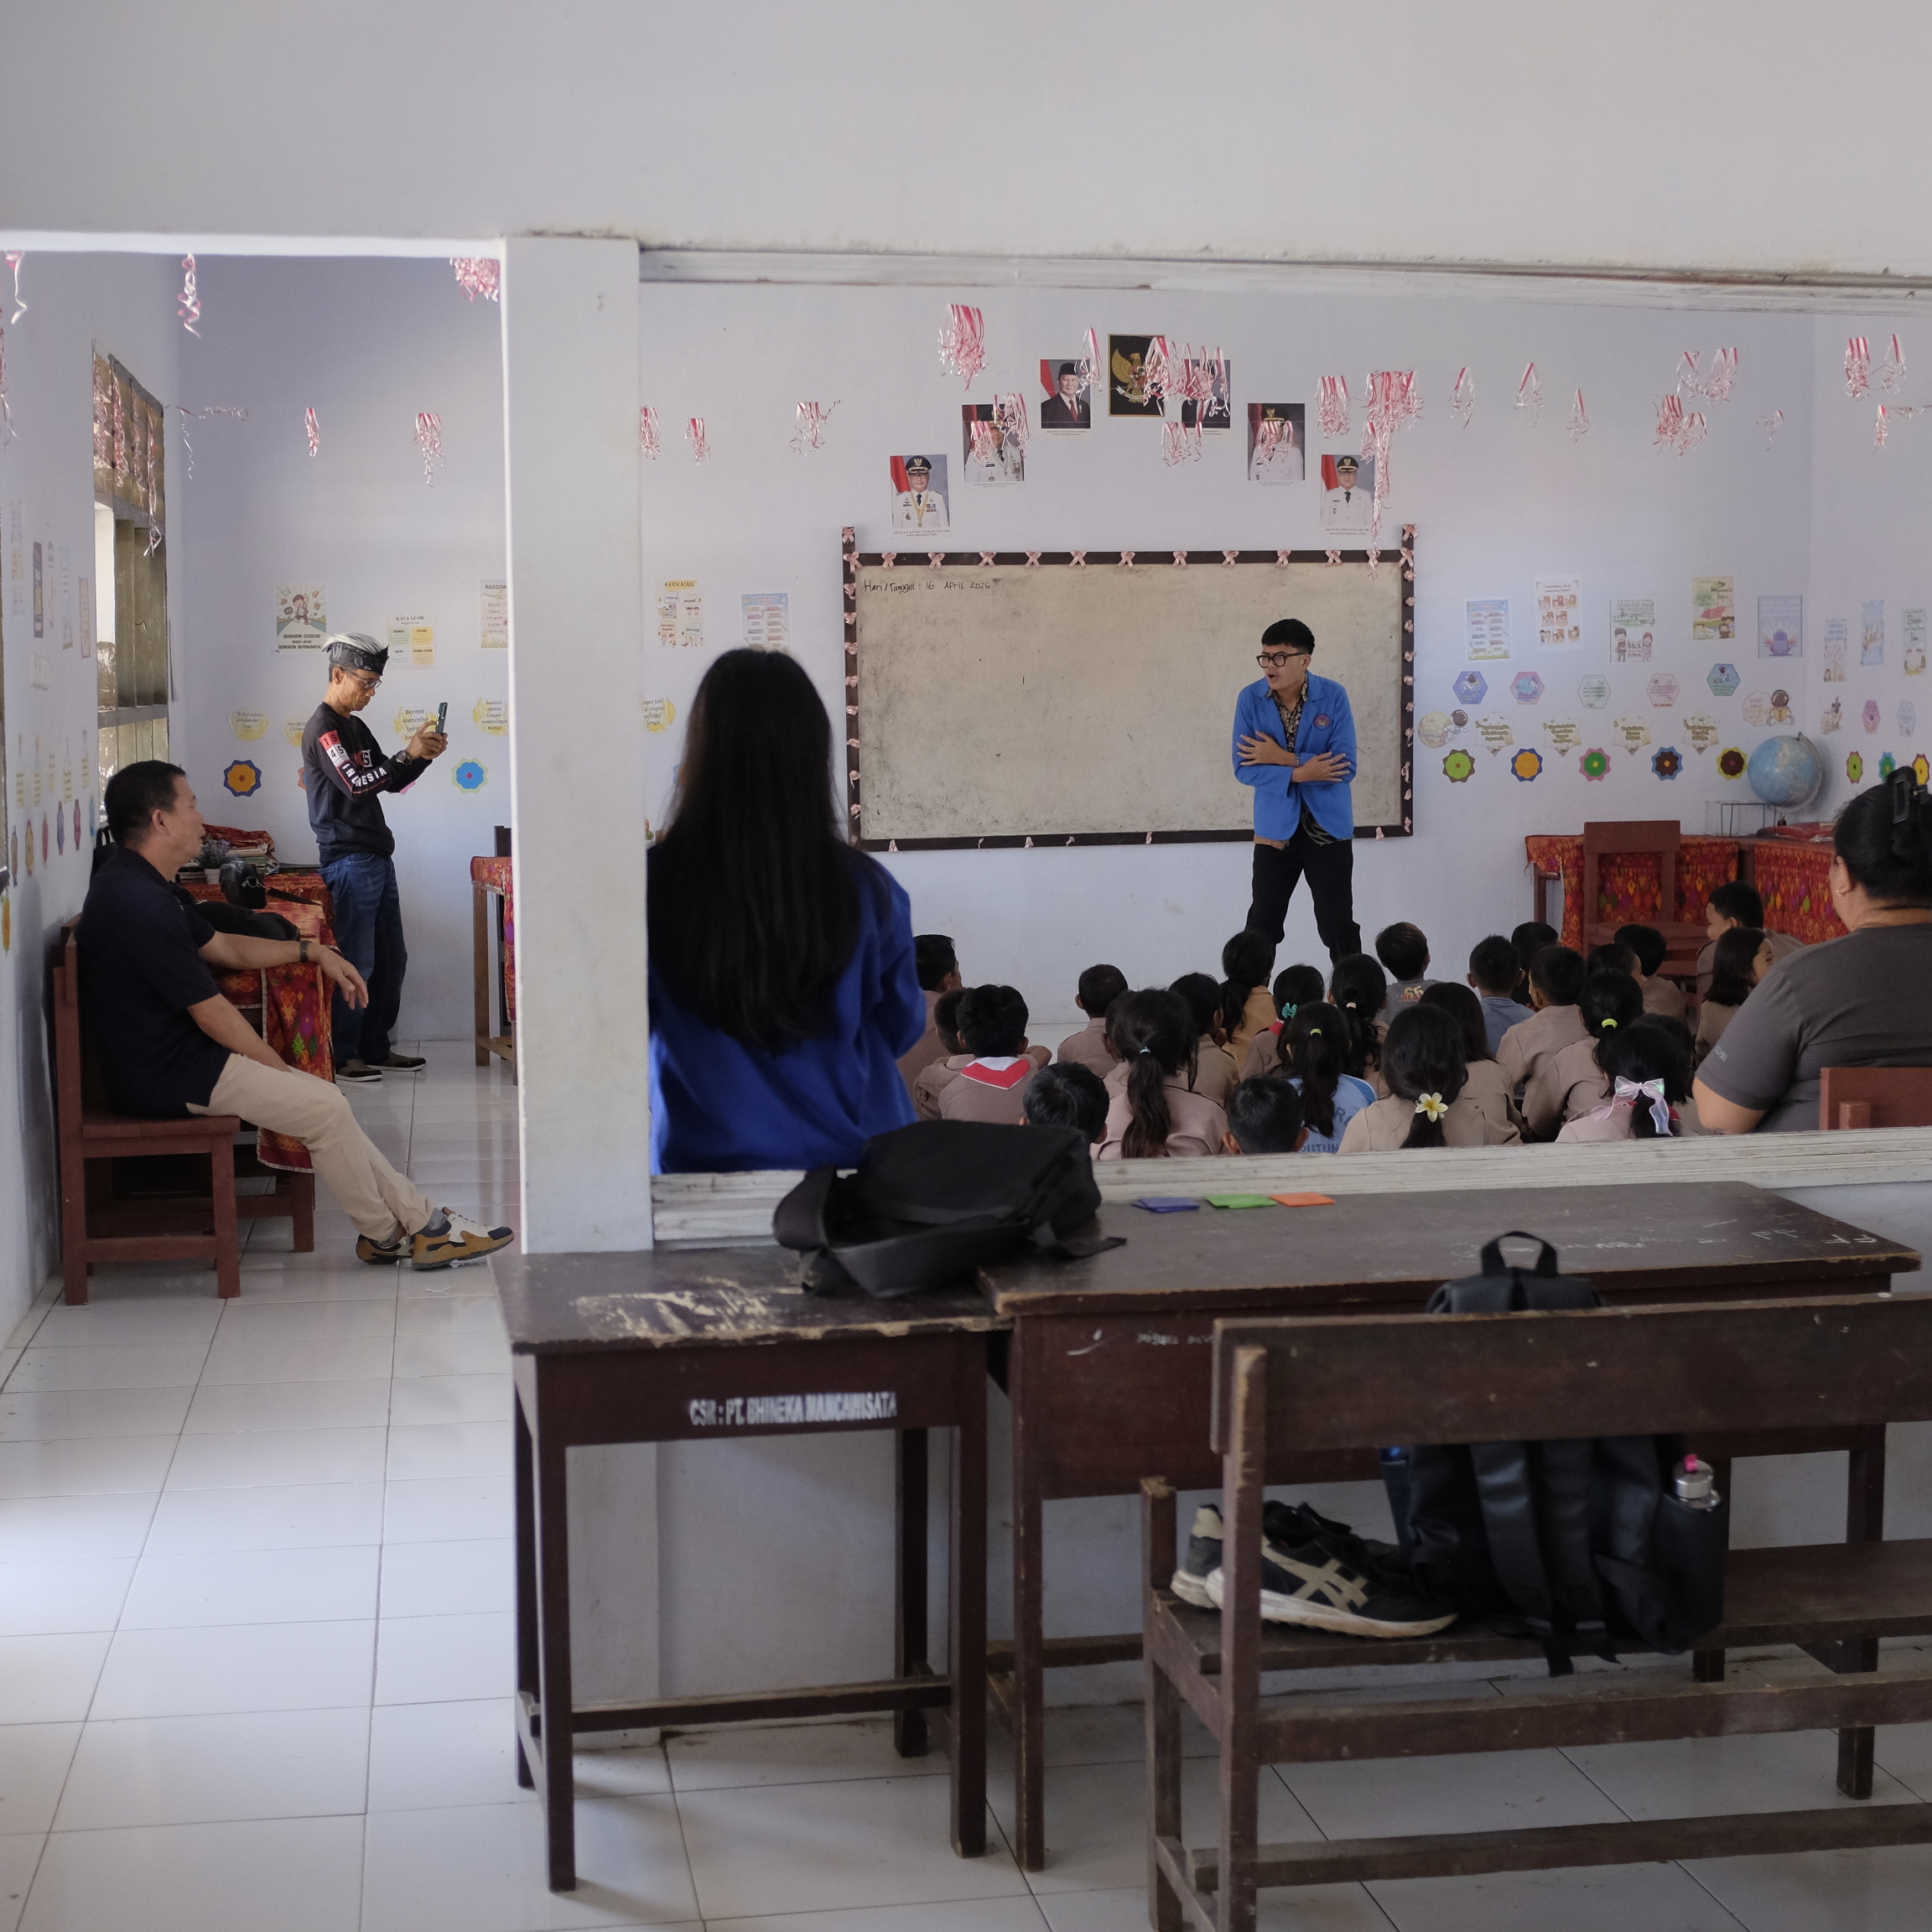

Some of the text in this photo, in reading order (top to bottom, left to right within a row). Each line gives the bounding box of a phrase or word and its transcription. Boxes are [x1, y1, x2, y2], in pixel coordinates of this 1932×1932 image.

[926, 581, 935, 589] 16
[970, 581, 991, 589] 2026
[341, 763, 387, 787] INNESIA
